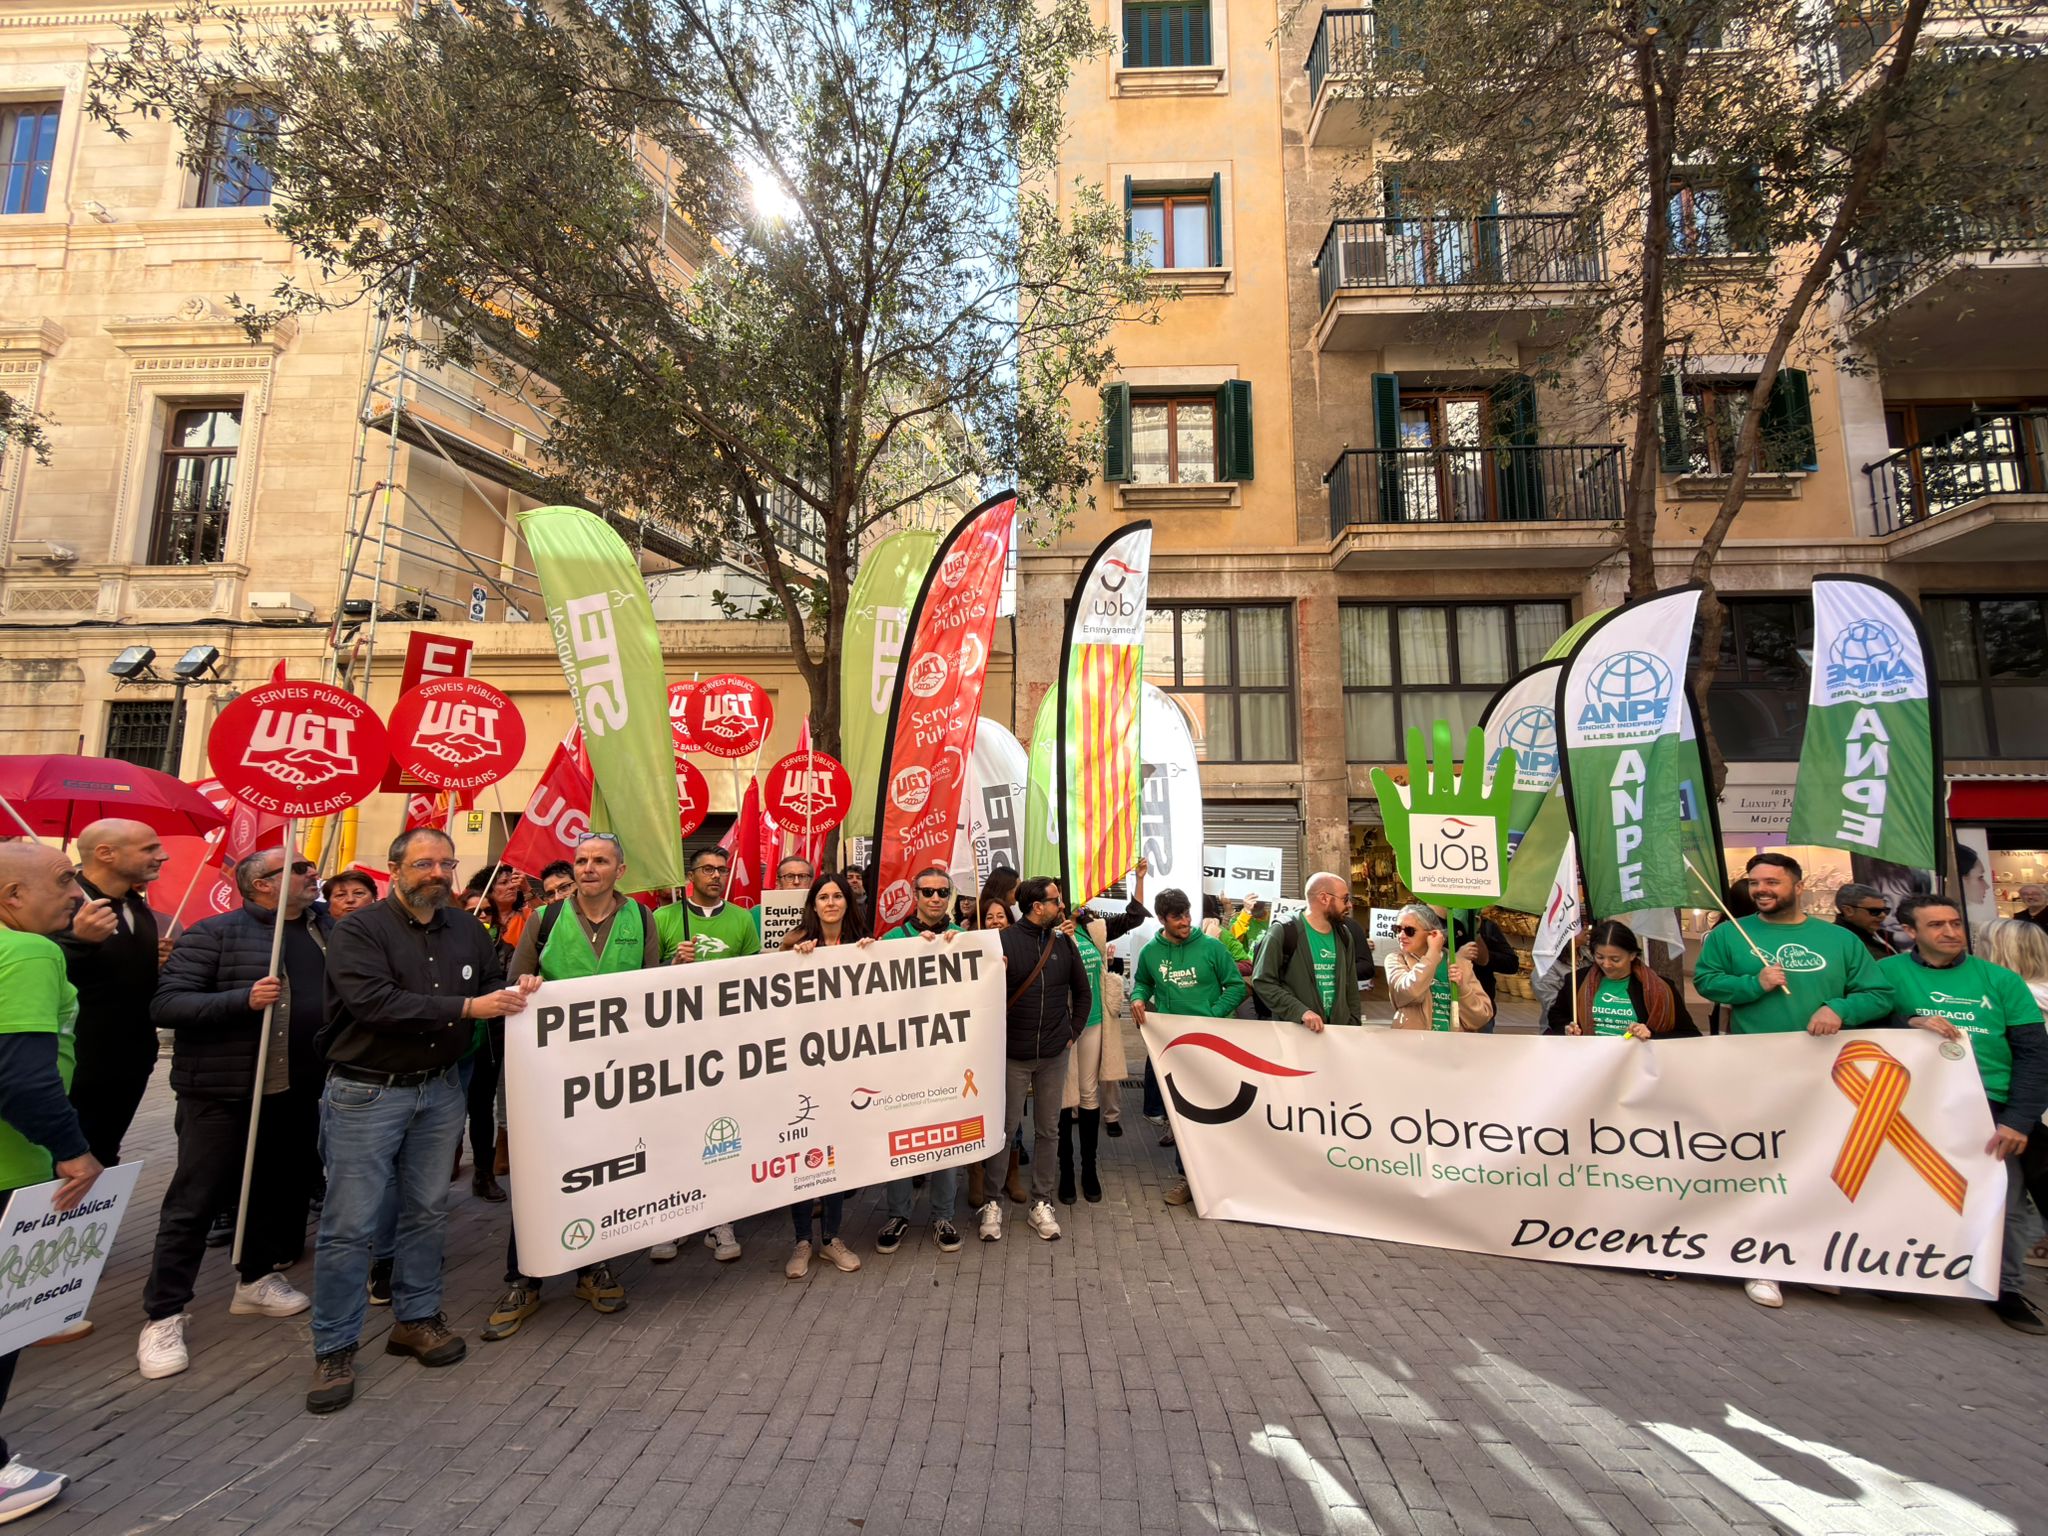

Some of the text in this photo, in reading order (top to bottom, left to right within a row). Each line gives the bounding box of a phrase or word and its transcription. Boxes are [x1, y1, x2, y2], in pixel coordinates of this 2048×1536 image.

[509, 453, 528, 466] ULMA
[1094, 593, 1134, 617] uob
[420, 682, 505, 709] SERVEIS PÚBLICS
[669, 683, 695, 694] SERVEIS
[699, 676, 756, 695] SERVEIS PÚBLICS
[251, 687, 364, 718] SERVEIS PÚBLICS
[703, 693, 753, 720] UGT
[1577, 697, 1671, 725] ANPE
[418, 700, 499, 741] UGT
[1577, 723, 1616, 731] SINDICAT
[250, 709, 356, 758] UGT
[1583, 733, 1614, 741] ILLES
[703, 738, 759, 756] ILLES BALEARS
[781, 754, 808, 770] SERVEIS
[409, 762, 498, 788] ILLES BALEARS
[782, 769, 833, 796] UGT
[896, 770, 930, 795] UGT
[1518, 779, 1552, 787] BALEA
[238, 785, 352, 815] ILLES BALEARS
[1741, 798, 1778, 810] Luxury
[780, 817, 799, 833] ILLES
[1609, 749, 1647, 903] ANPE
[1419, 843, 1489, 871] UOB
[1231, 866, 1275, 882] STEI
[1418, 874, 1492, 885] unió obrera balear
[1274, 902, 1289, 914] Ja
[1376, 921, 1388, 930] de
[1168, 966, 1197, 979] CRIDA!
[536, 949, 983, 1048] PER UN ENSENYAMENT
[1915, 1008, 1975, 1021] EDUCACIÓ
[563, 1009, 971, 1119] PÚBLIC DE QUALITAT
[872, 1085, 958, 1107] unió obrera balear
[779, 1126, 809, 1143] SIAU
[895, 1125, 958, 1151] CCOO
[1266, 1100, 1787, 1163] unió obrera balear
[702, 1137, 742, 1157] ANPE
[890, 1138, 986, 1167] ensenyament
[560, 1150, 647, 1194] STEI
[751, 1151, 800, 1184] UGT
[794, 1168, 836, 1184] Ensenyament
[1327, 1146, 1788, 1201] Consell sectorial d'Ensenyament
[794, 1176, 837, 1192] Serveis Públics
[601, 1188, 707, 1229] alternativa.
[601, 1201, 705, 1240] SINDICAT DOCENT
[12, 1217, 41, 1237] Per
[41, 1213, 57, 1228] la
[1510, 1218, 1709, 1260] Docents
[1730, 1236, 1796, 1266] en
[33, 1277, 83, 1305] escola
